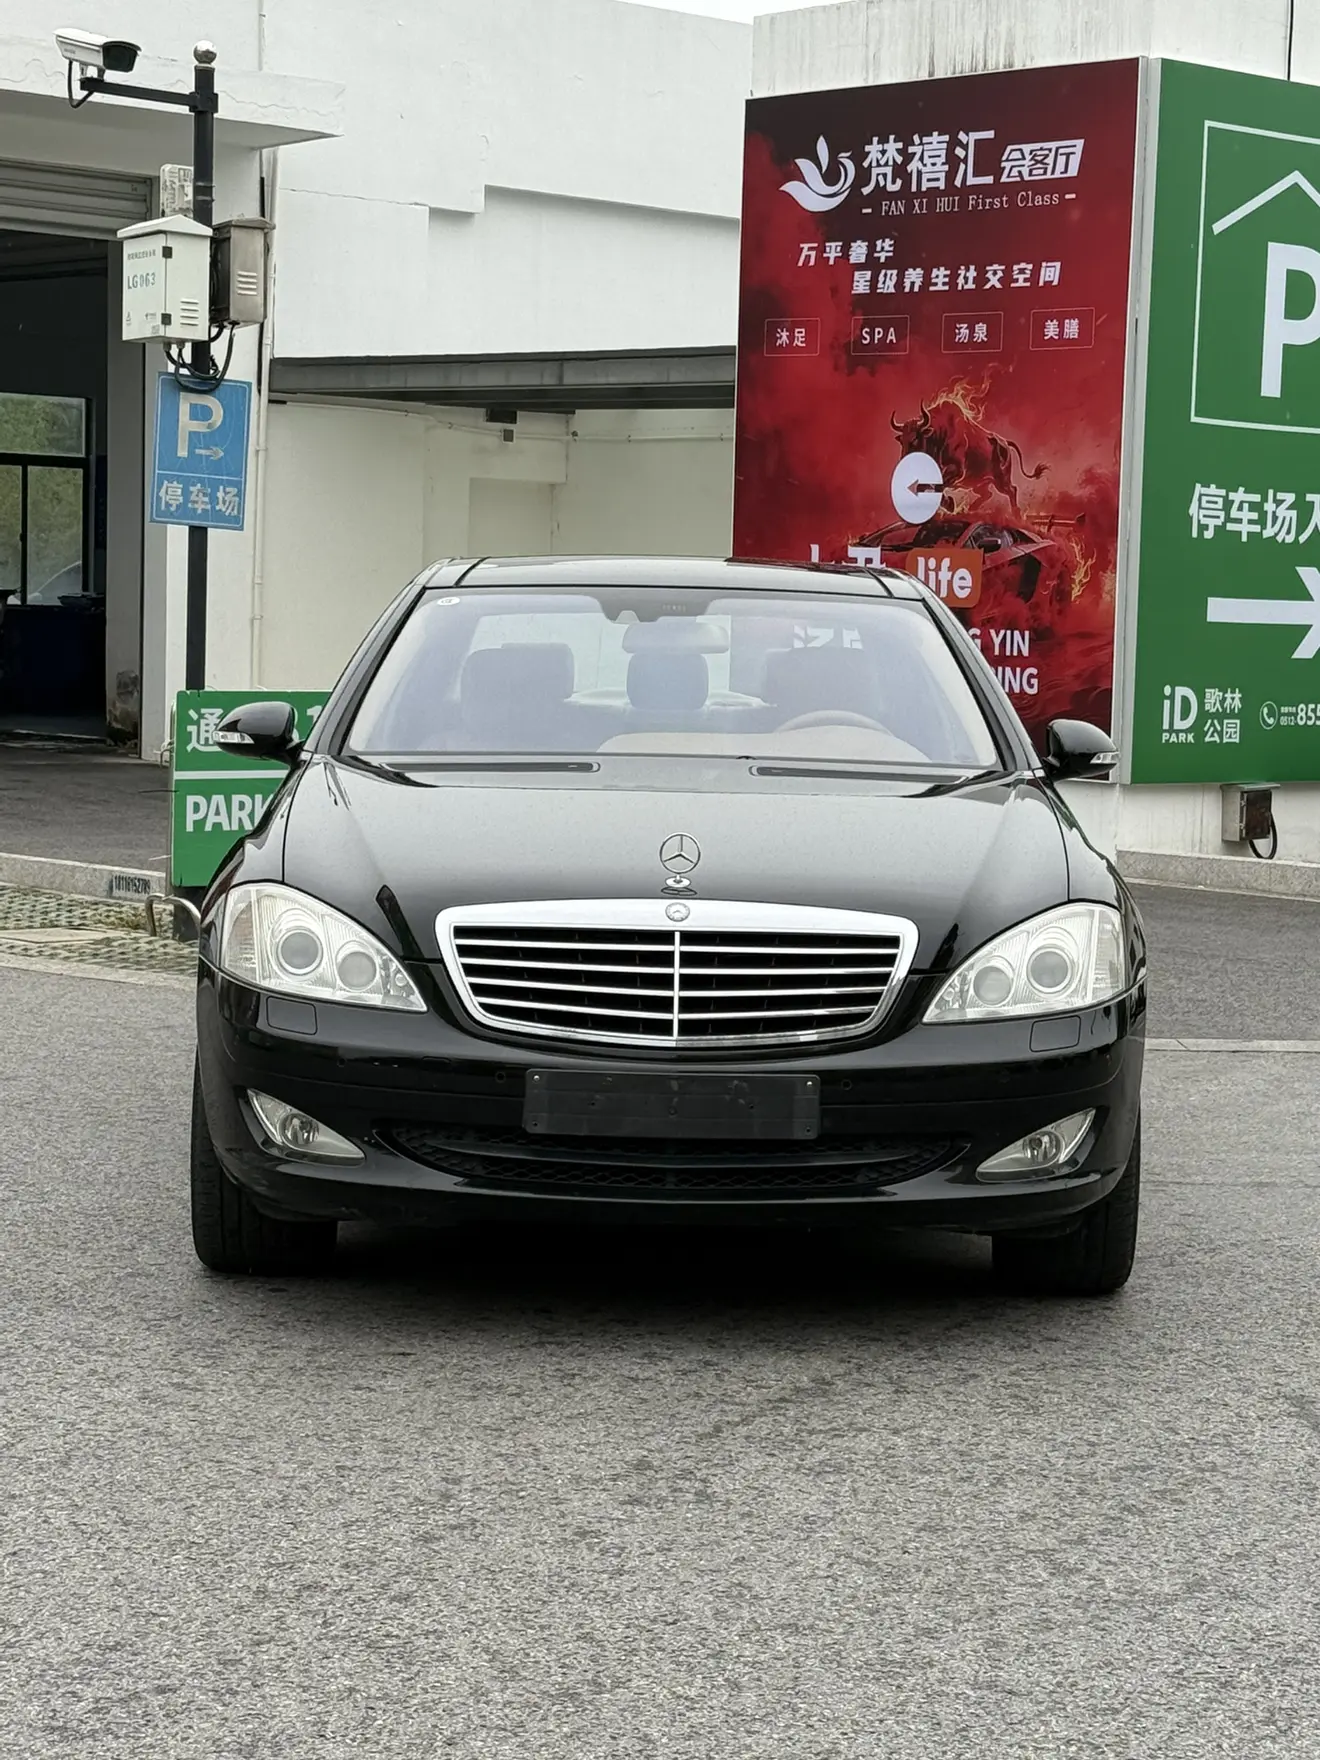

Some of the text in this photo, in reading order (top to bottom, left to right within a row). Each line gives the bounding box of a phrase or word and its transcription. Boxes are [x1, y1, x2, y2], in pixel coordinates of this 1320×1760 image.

[860, 129, 1085, 195] 梵禧汇 会客厅
[881, 190, 1060, 216] FAN XI HUI First Class
[797, 239, 895, 267] 万平奢华
[127, 272, 156, 289] LG063
[851, 261, 1061, 295] 星级养生社交空间
[1043, 318, 1080, 341] 美膳
[1260, 240, 1320, 398] P
[775, 327, 808, 348] 沐足
[862, 326, 898, 345] SPA
[955, 322, 990, 344] 汤泉
[177, 392, 224, 458] P
[158, 480, 241, 518] 停车场
[917, 556, 973, 599] life
[989, 628, 1030, 657] YIN
[991, 666, 1039, 695] ING
[1204, 687, 1242, 714] 歌林
[1161, 732, 1195, 744] PARK
[1204, 718, 1241, 744] 公园
